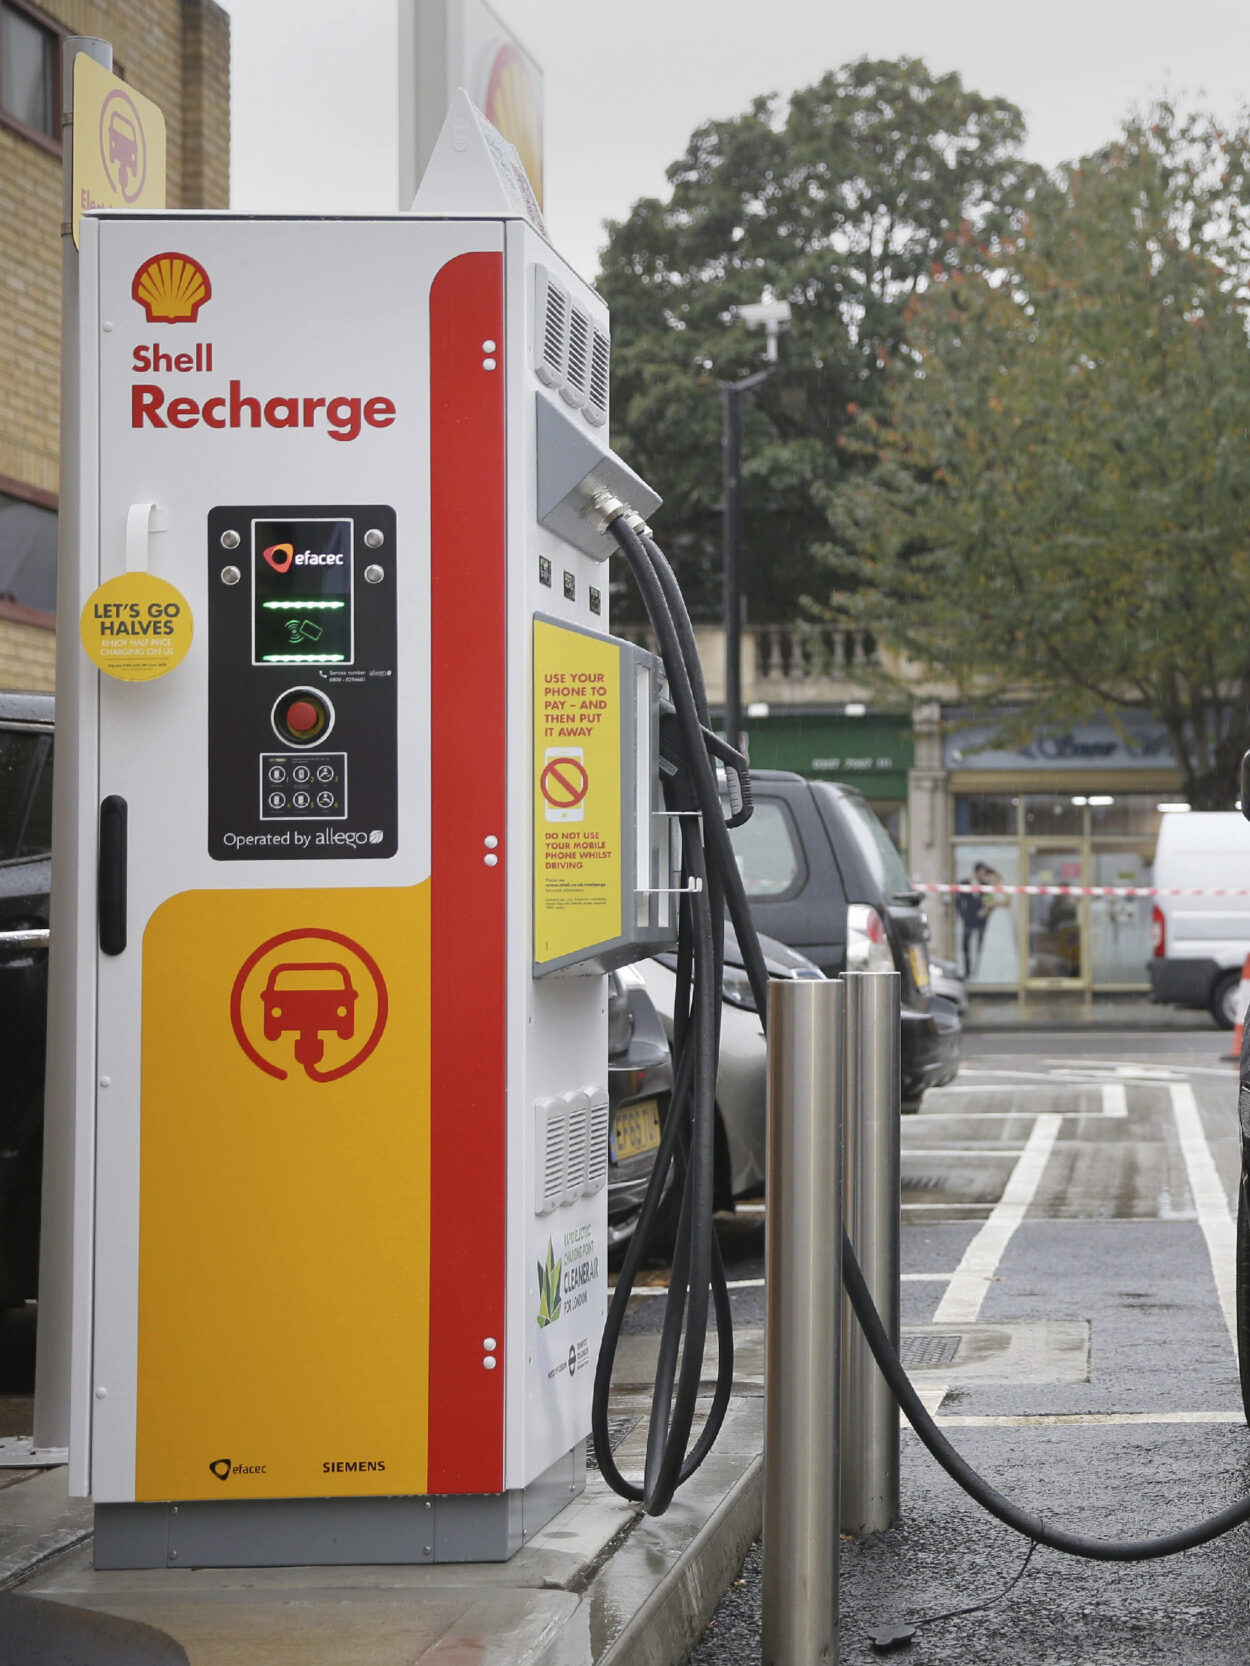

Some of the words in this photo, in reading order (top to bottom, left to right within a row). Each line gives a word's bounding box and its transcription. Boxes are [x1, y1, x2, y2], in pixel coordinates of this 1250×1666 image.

[132, 343, 213, 373] Shell
[131, 380, 397, 442] Recharge
[294, 550, 344, 565] efacec
[94, 603, 140, 618] LET'S
[147, 603, 181, 618] GO
[100, 620, 175, 636] HALVES
[100, 648, 145, 657] CHARGING
[544, 674, 566, 683] USE
[570, 673, 605, 683] YOUR
[544, 687, 587, 697] PHONE
[591, 687, 607, 696] TO
[544, 701, 567, 710] PAY
[580, 700, 607, 710] AND
[544, 714, 576, 723] THEN
[580, 713, 602, 723] PUT
[544, 727, 554, 737] IT
[558, 727, 593, 737] AWAY
[223, 831, 290, 850] Operated
[294, 831, 312, 849] by
[315, 827, 368, 849] allego
[545, 832, 559, 840] DO
[545, 842, 571, 850] YOUR
[573, 841, 606, 849] MOBILE
[545, 852, 577, 860] PHONE
[579, 851, 613, 859] WHILST
[545, 862, 584, 870] DRIVING
[564, 1261, 591, 1294] CLEANER
[590, 1256, 599, 1280] AIR
[572, 1290, 588, 1311] LONDON
[232, 1464, 267, 1475] efacec
[323, 1461, 386, 1473] SIEMENS
